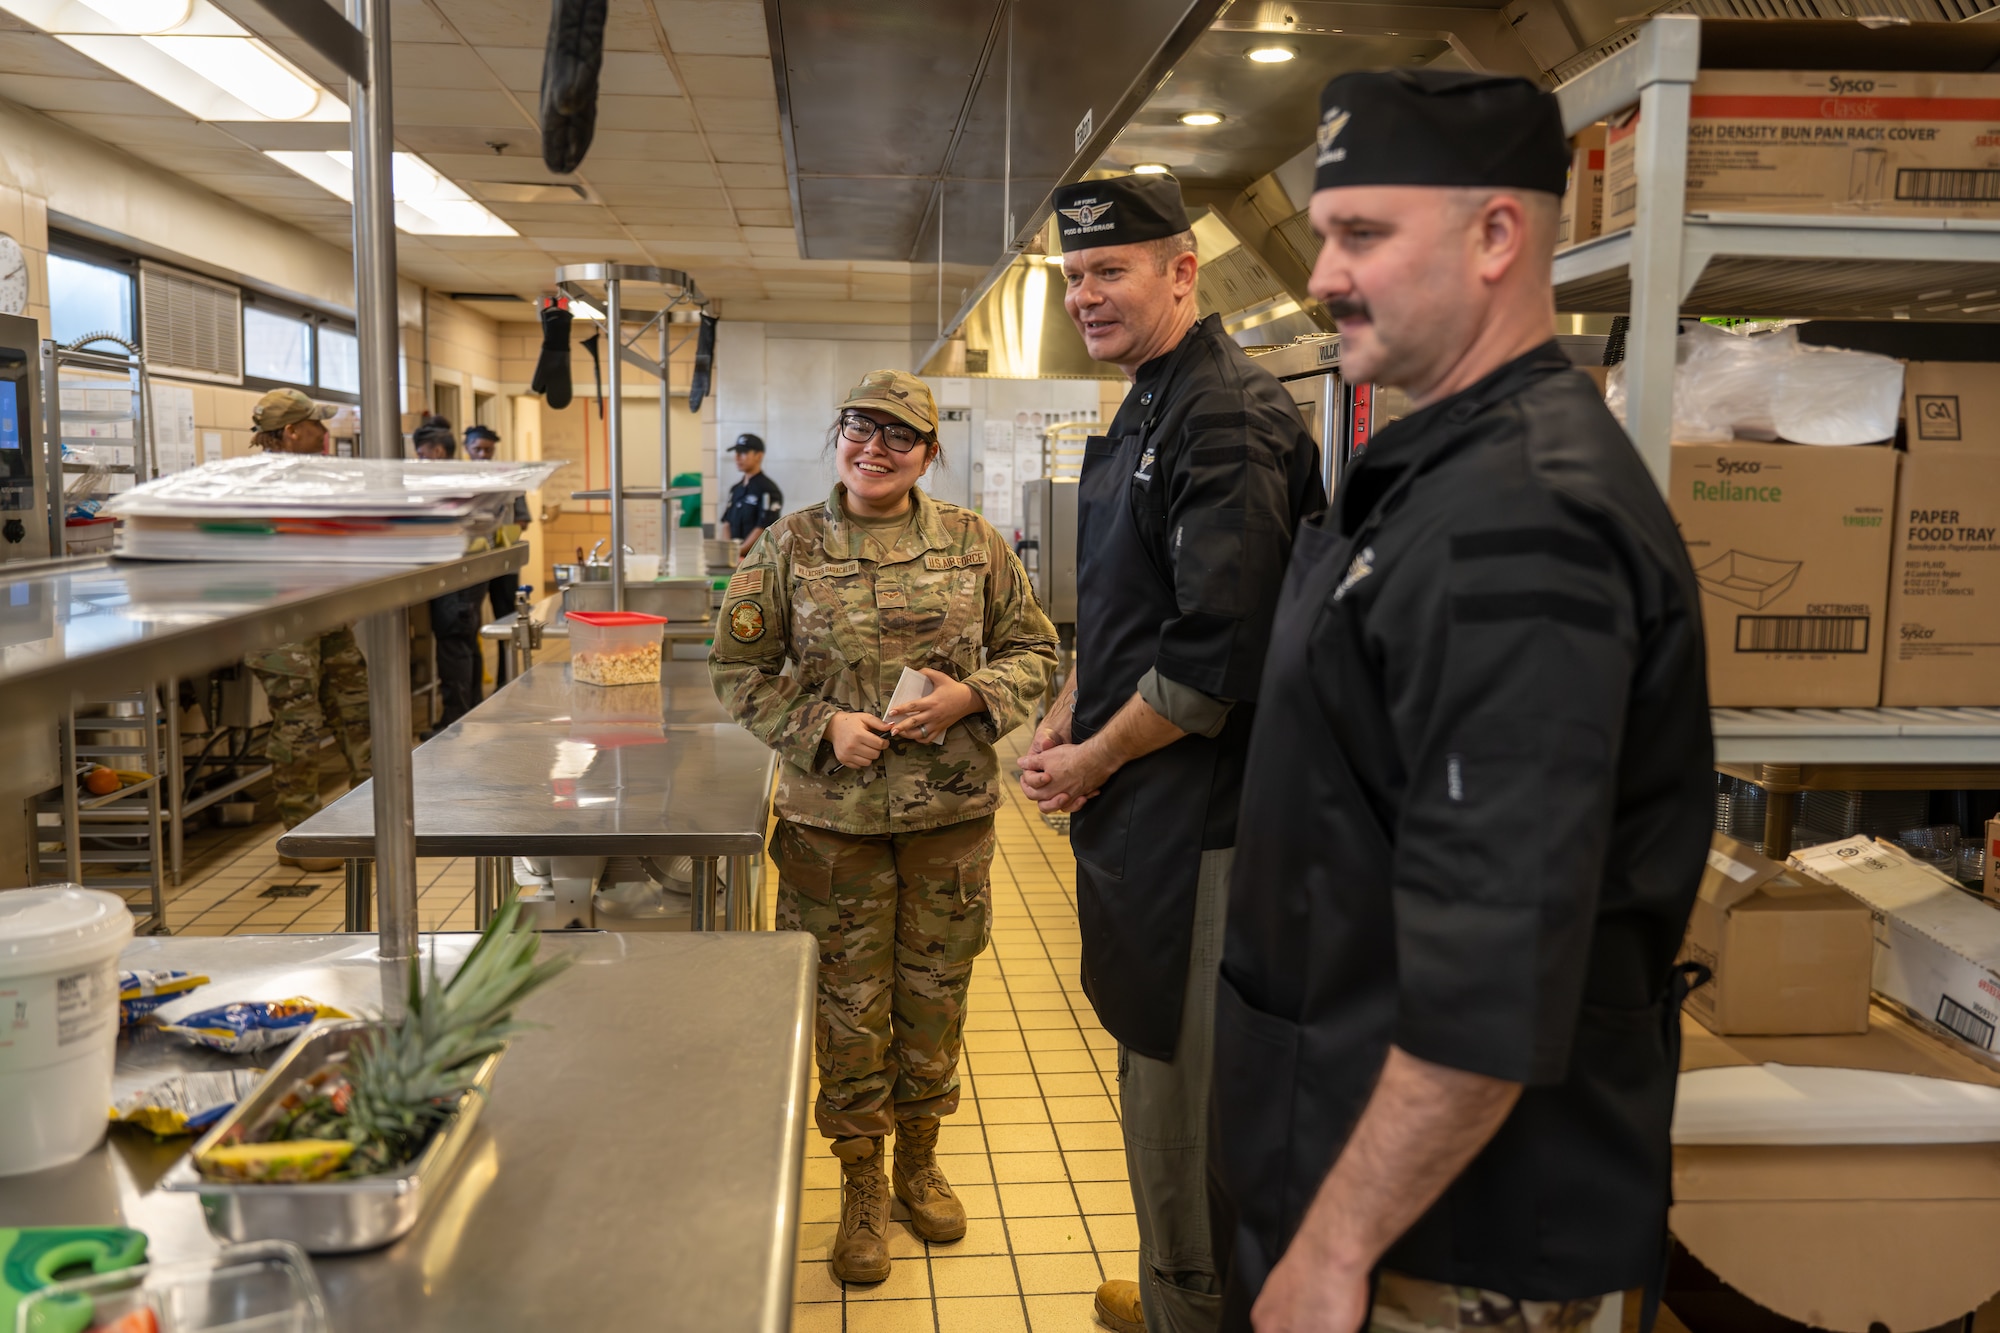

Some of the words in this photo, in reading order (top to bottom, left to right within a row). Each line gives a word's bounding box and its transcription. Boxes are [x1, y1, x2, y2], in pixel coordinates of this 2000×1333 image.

[1829, 76, 1875, 95] Sysco
[1820, 98, 1879, 119] Classic
[1688, 125, 1713, 138] IGH
[1716, 125, 1778, 139] DENSITY
[1781, 126, 1811, 139] BUN
[1814, 126, 1844, 140] PAN
[1847, 127, 1885, 141] RACK
[1888, 127, 1936, 141] COVER
[1073, 199, 1082, 207] AIR
[1082, 197, 1097, 206] FORCE
[1063, 228, 1077, 236] FOOD
[1082, 222, 1115, 234] BEVERAGE
[1716, 457, 1761, 476] Sysco
[1692, 480, 1782, 503] Reliance
[1909, 509, 1960, 524] PAPER
[1908, 527, 1954, 542] FOOD
[1956, 527, 1997, 542] TRAY
[943, 556, 957, 569] AIR
[957, 552, 984, 567] FORCE
[1900, 627, 1936, 641] Sysco
